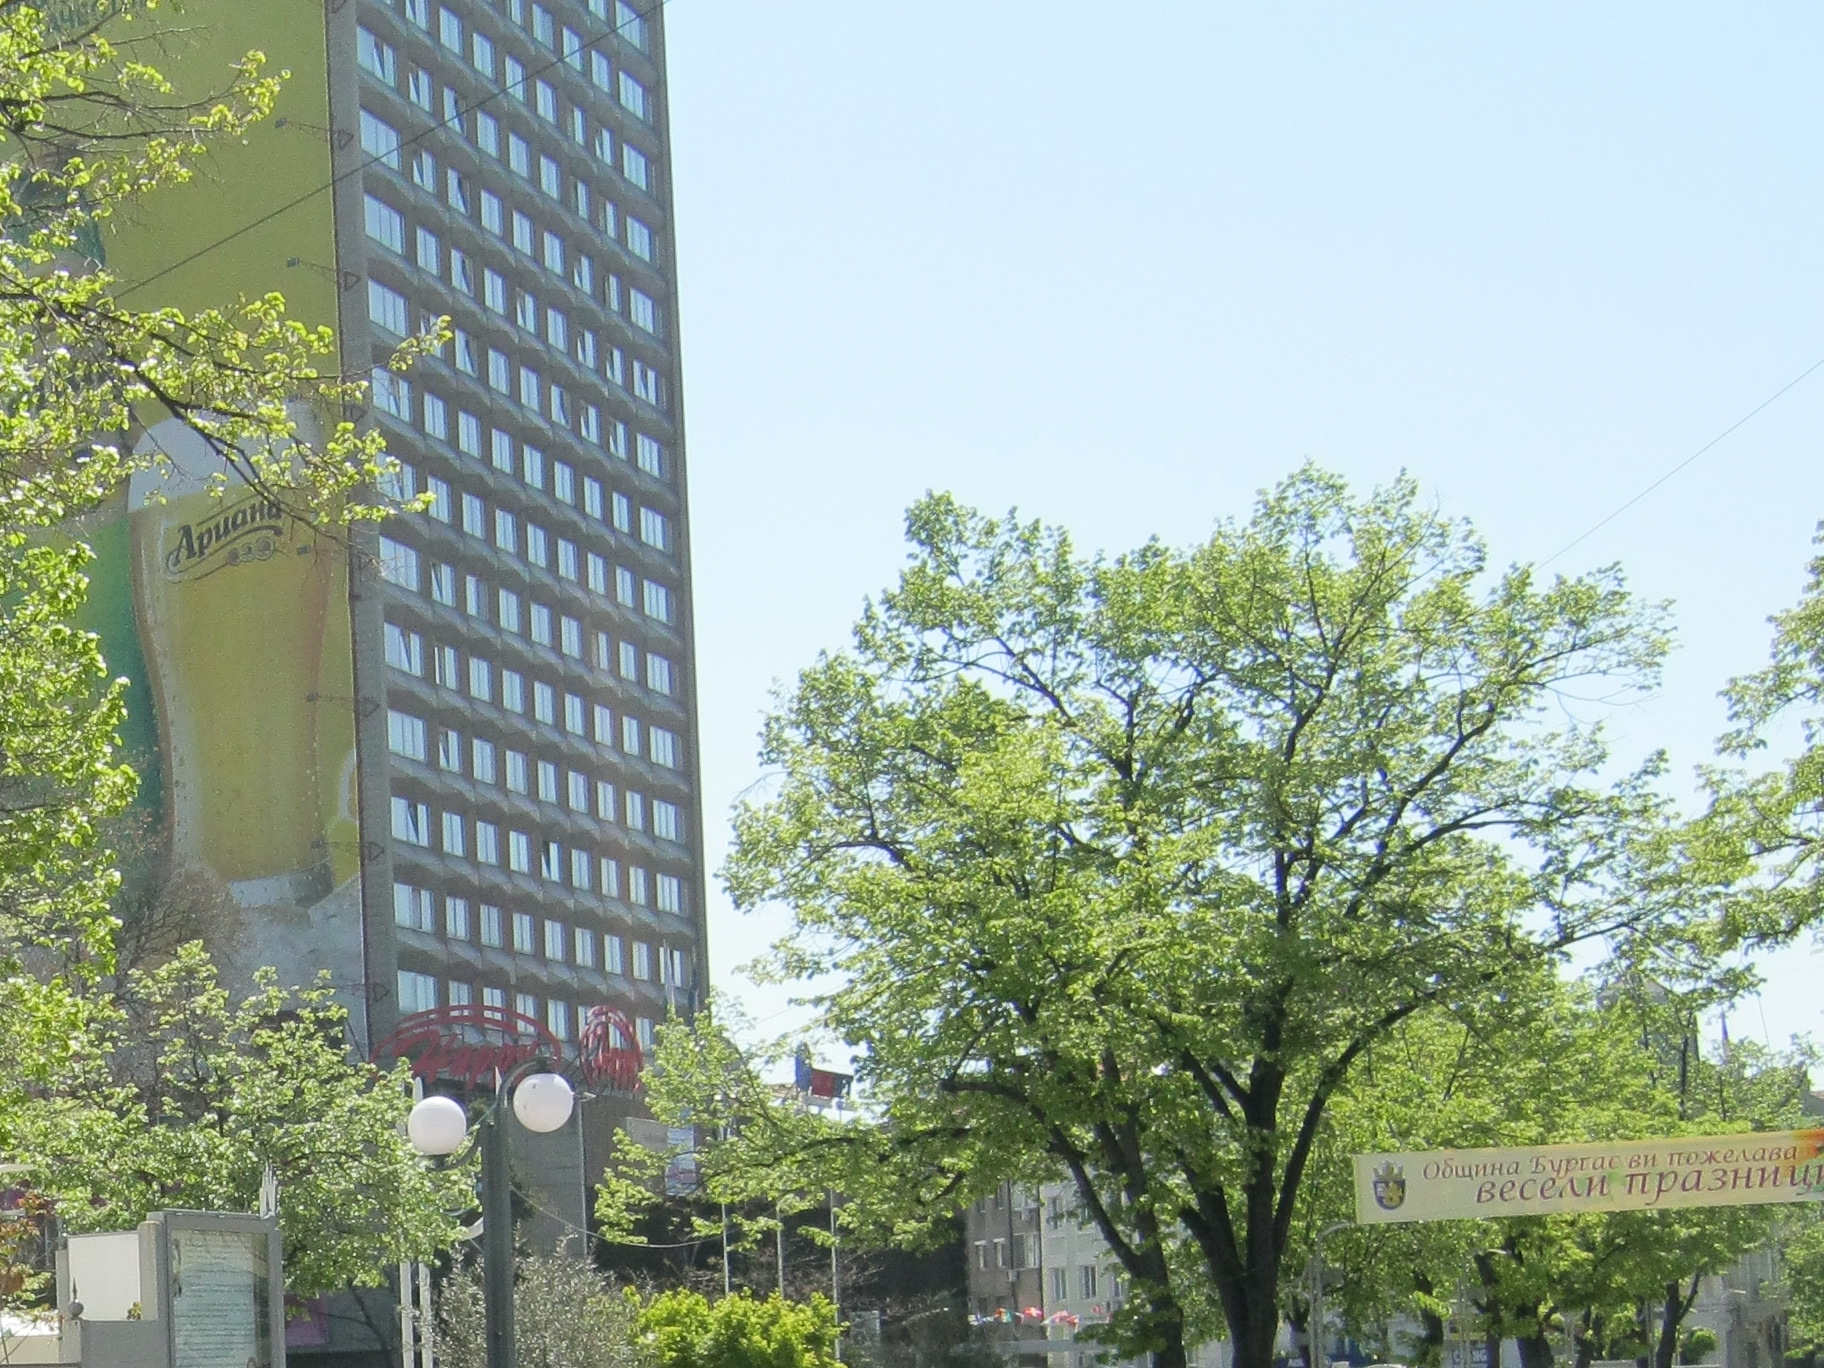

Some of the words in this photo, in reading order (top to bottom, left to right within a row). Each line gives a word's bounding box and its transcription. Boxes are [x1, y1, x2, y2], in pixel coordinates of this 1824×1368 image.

[1423, 1157, 1521, 1181] Община
[1529, 1154, 1620, 1179] Бургас
[1628, 1153, 1657, 1169] ви
[1667, 1145, 1798, 1166] пожелава
[1476, 1174, 1610, 1204] весели
